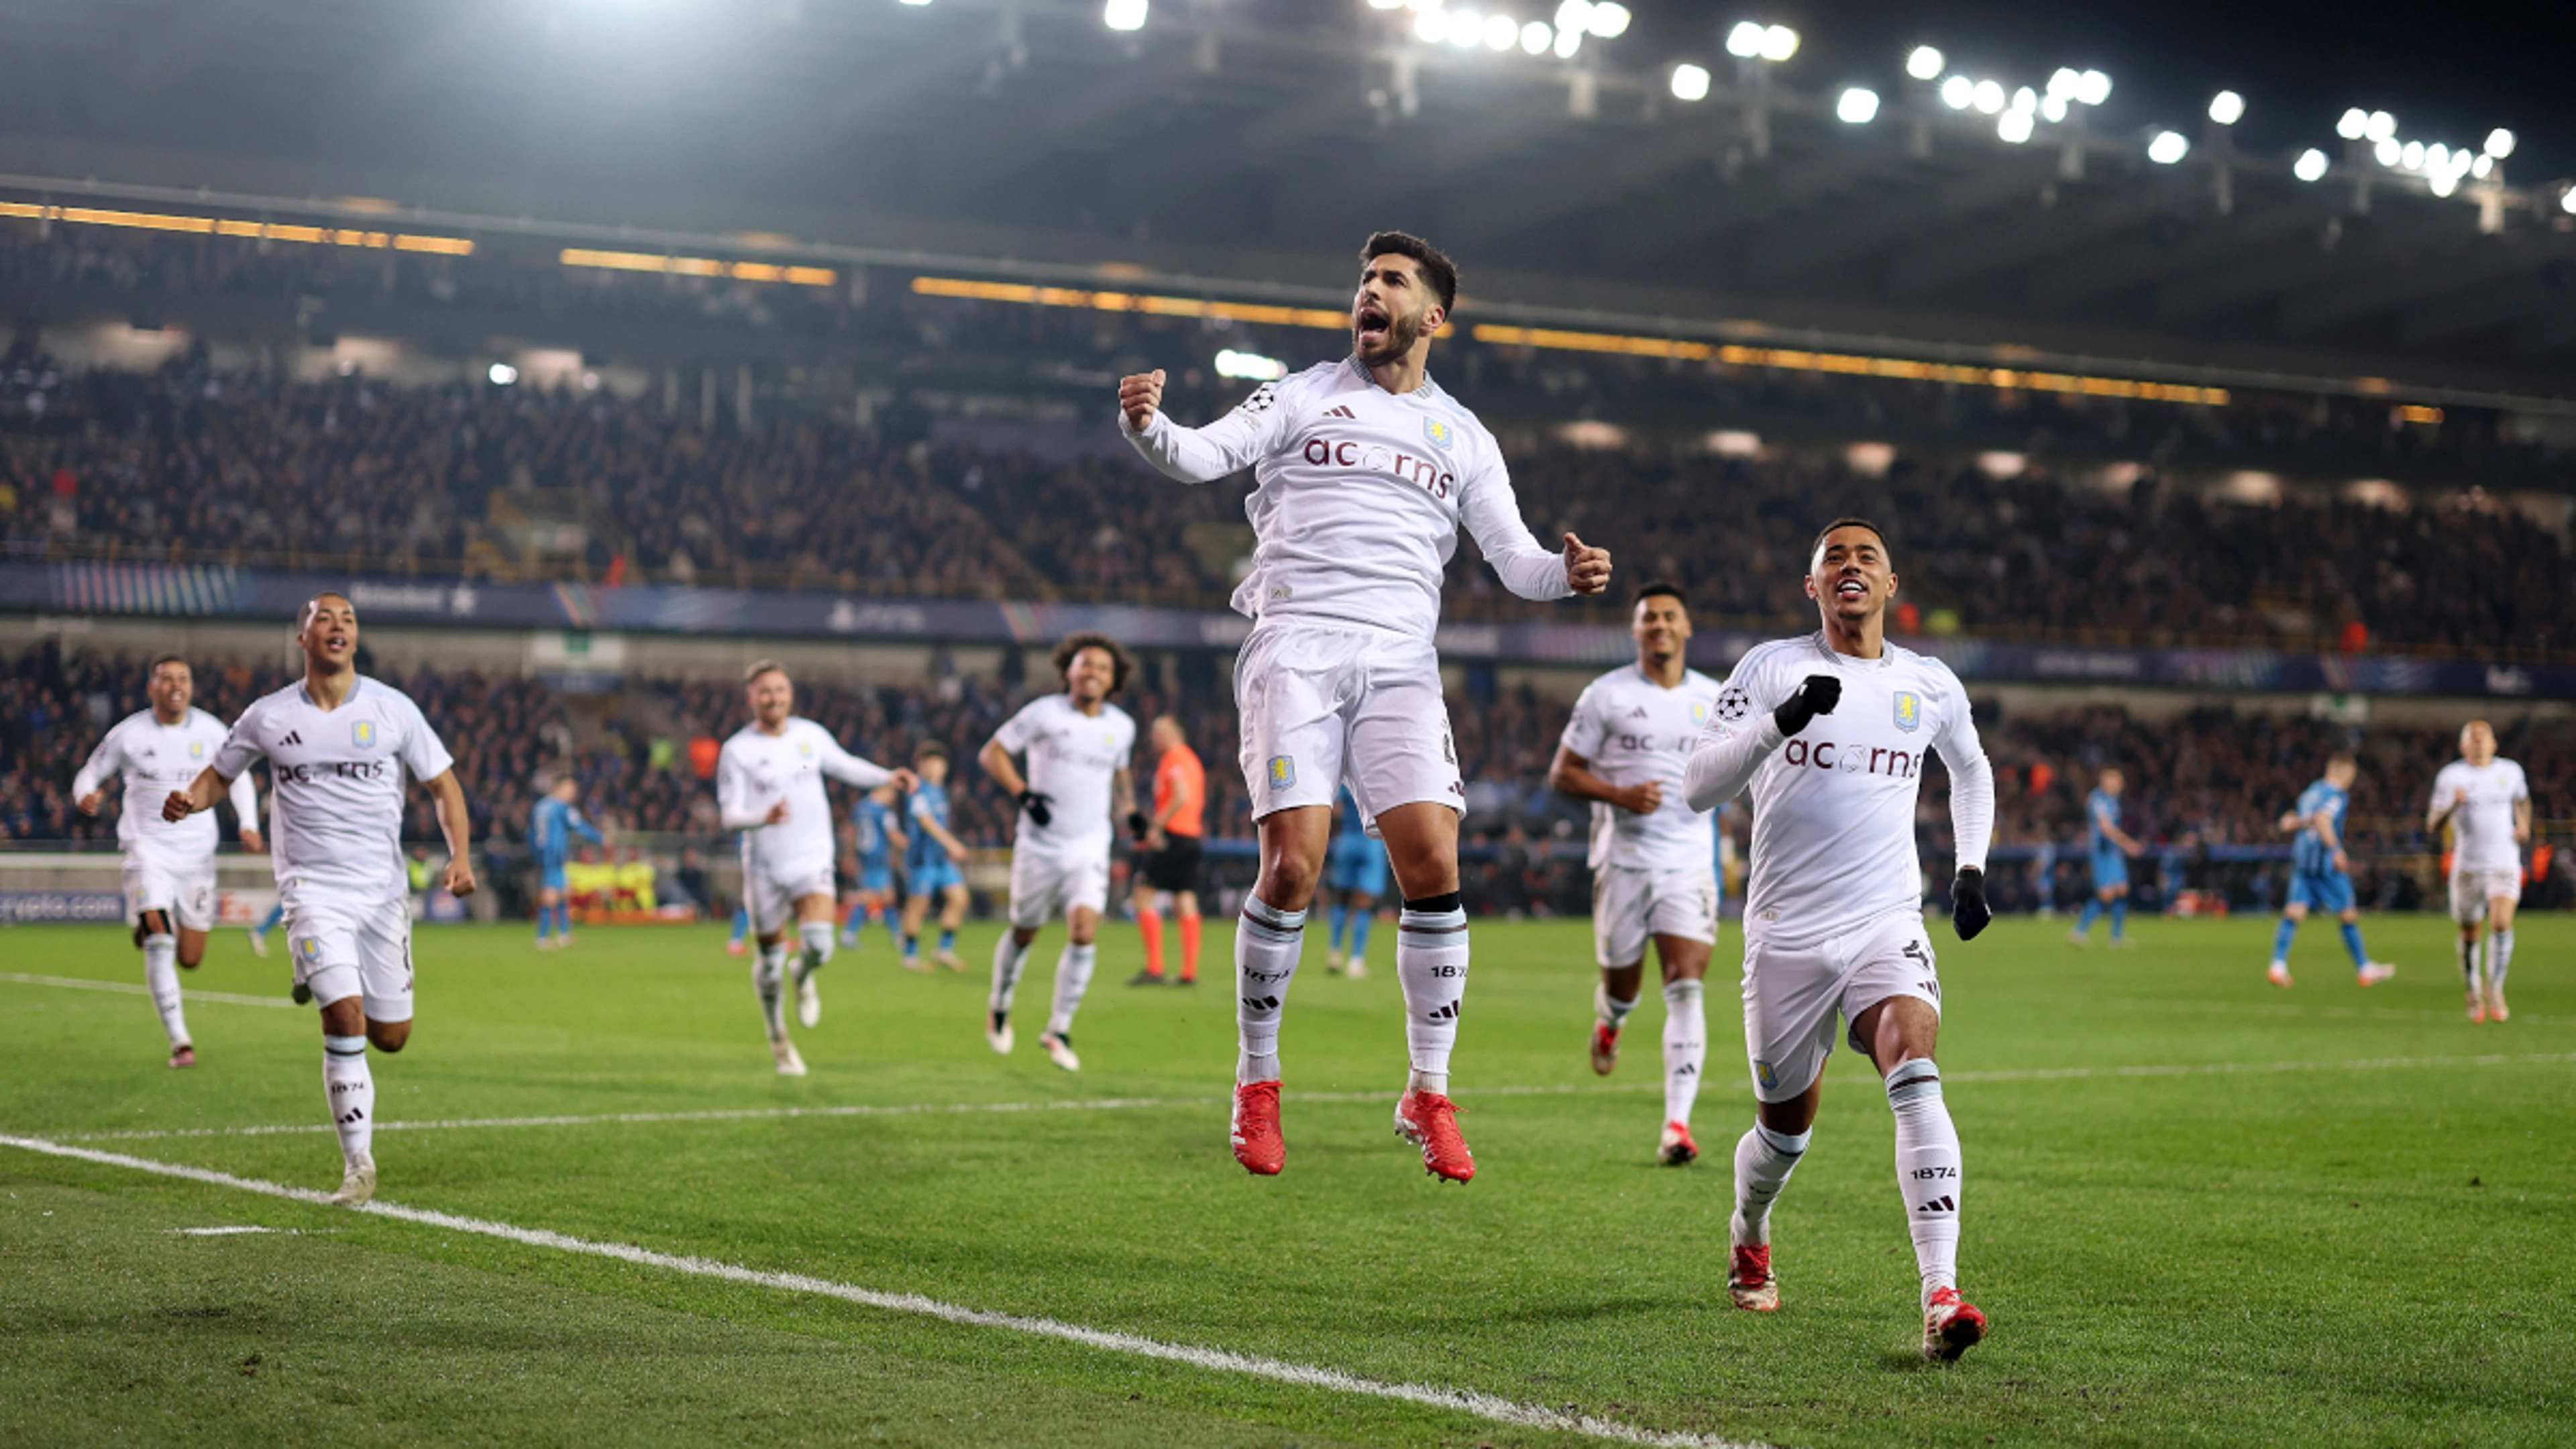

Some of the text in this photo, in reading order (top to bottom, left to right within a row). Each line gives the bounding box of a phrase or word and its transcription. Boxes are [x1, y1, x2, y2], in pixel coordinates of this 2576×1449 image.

[1303, 438, 1454, 500] acorns
[278, 759, 384, 783] acrns
[1431, 965, 1468, 977] 187
[1910, 1167, 1957, 1179] 1874
